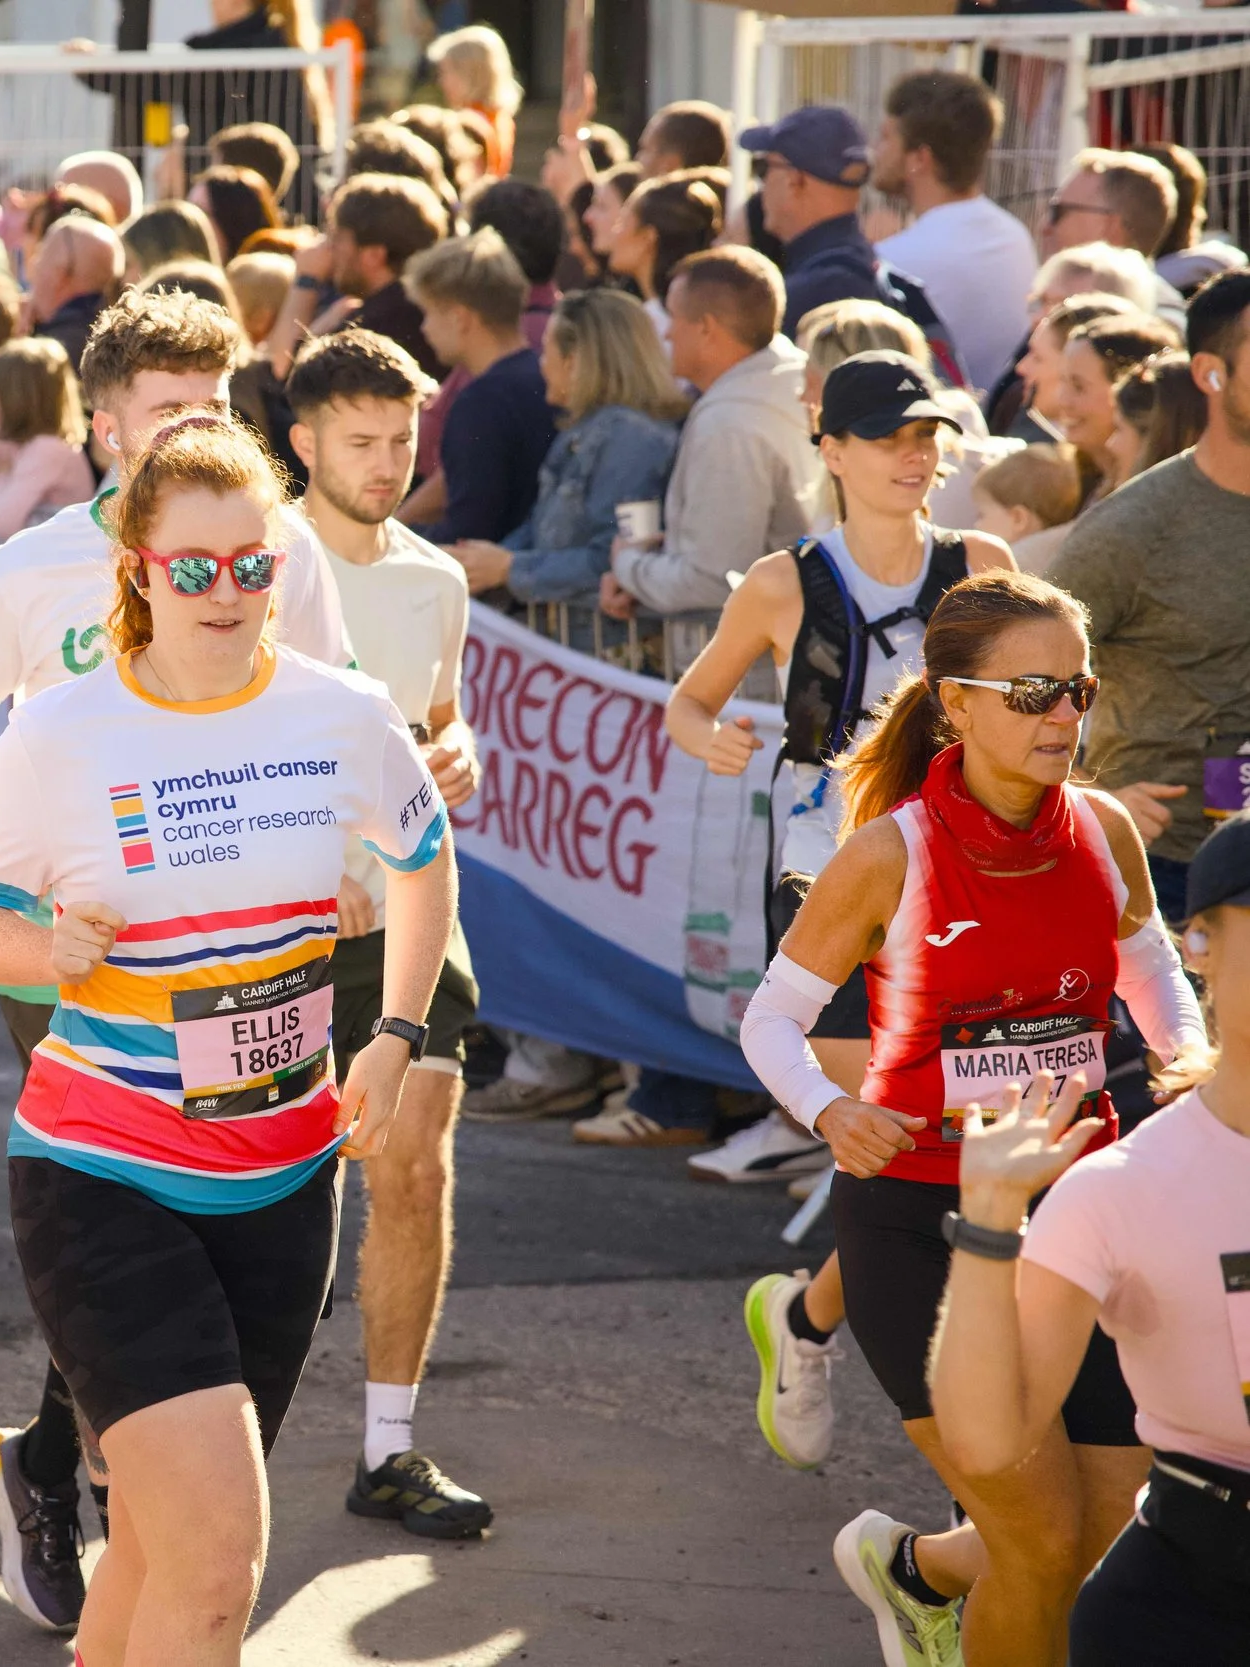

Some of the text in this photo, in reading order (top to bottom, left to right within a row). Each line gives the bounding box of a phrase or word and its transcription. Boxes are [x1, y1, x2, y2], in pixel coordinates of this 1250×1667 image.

[462, 635, 670, 794] BRECON
[152, 759, 338, 799] ymchwil canser
[158, 794, 237, 822] cymru
[163, 805, 337, 842] cancer research
[169, 842, 240, 867] wales
[241, 970, 307, 999] CARDIFF HALF
[242, 997, 265, 1007] HANNER
[265, 990, 290, 1003] MARATHON
[231, 1006, 300, 1046] ELLIS
[1009, 1015, 1083, 1033] CARDIFF HALF
[1034, 1030, 1058, 1039] MARATHON
[230, 1032, 304, 1077] 18637
[288, 1054, 320, 1074] UNISEX MEDIUM
[955, 1038, 1098, 1078] MARIA TERESA
[216, 1082, 247, 1092] PINK PEN
